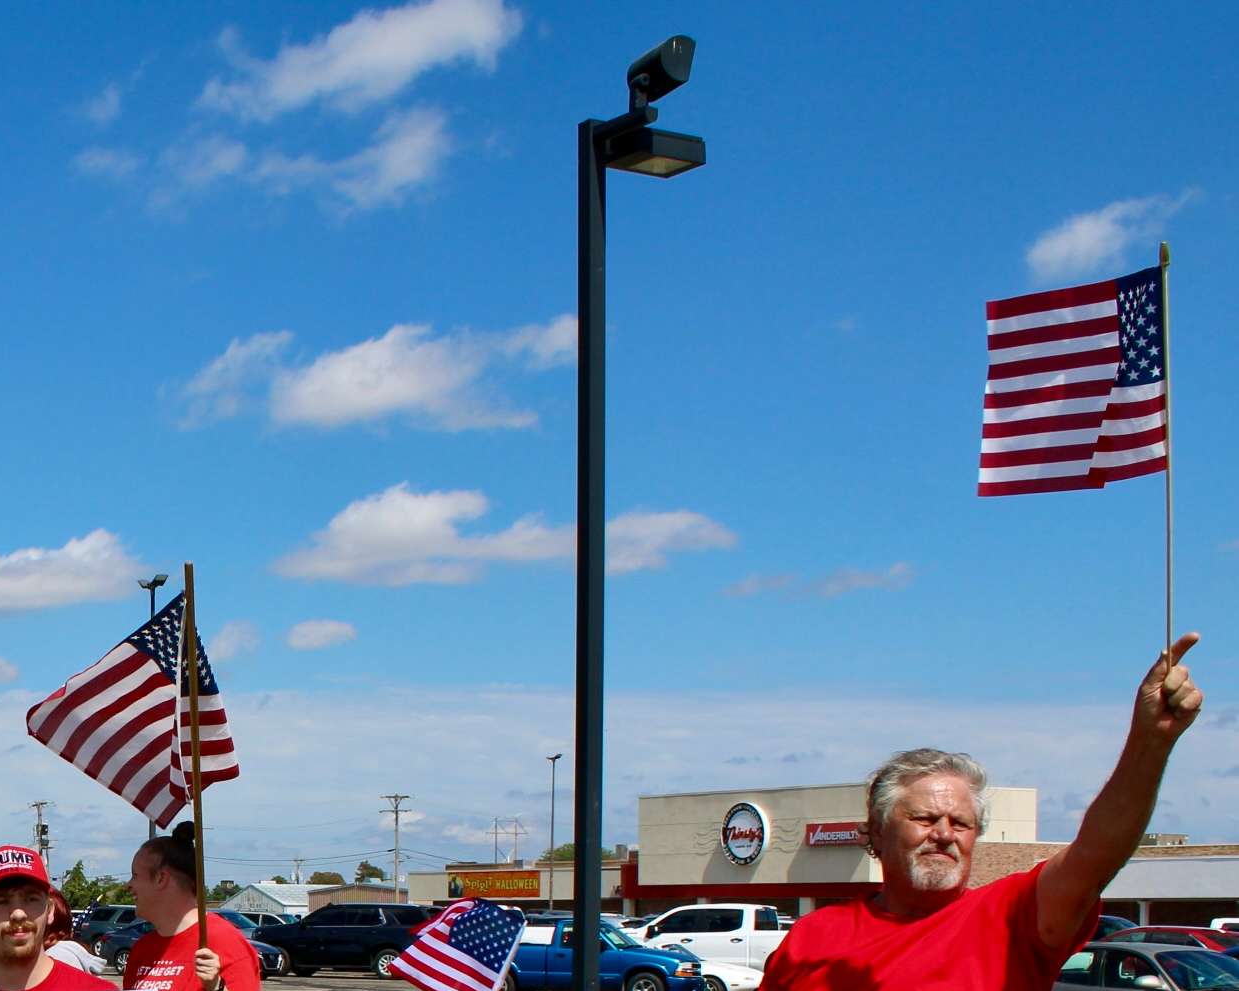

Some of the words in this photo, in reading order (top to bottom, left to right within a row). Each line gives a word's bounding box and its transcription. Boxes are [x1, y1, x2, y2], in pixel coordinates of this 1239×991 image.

[496, 878, 538, 890] HALLOWEEN
[163, 965, 185, 977] GET
[141, 980, 174, 991] SHOES
